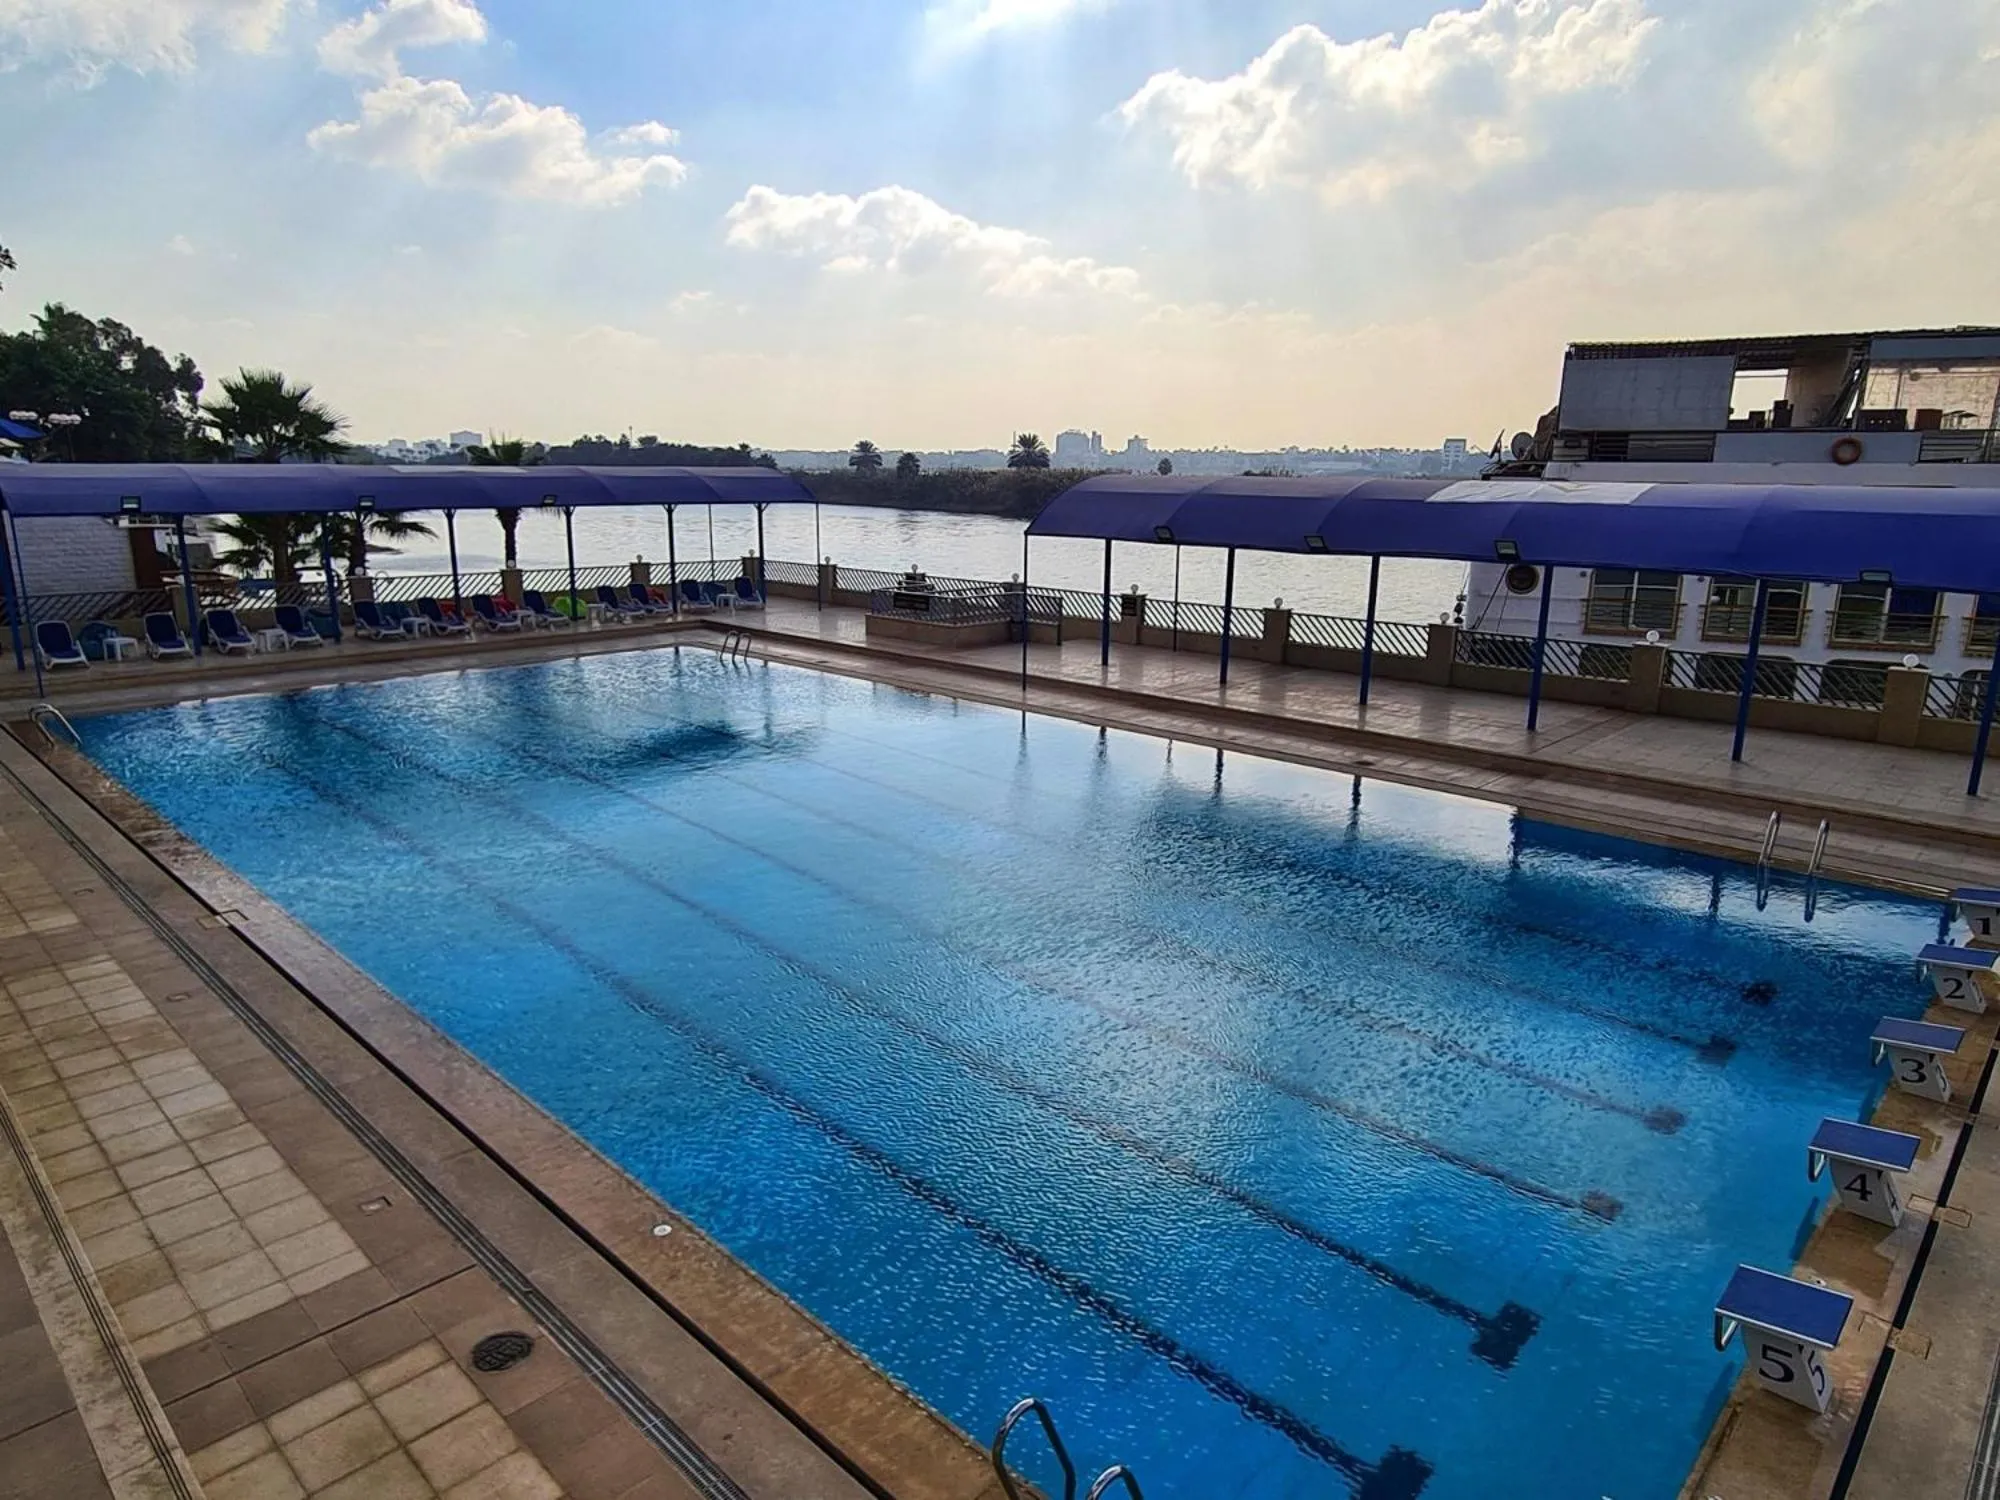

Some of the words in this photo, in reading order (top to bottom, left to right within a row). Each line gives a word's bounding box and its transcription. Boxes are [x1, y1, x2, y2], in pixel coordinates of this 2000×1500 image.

[1975, 916, 1992, 936] 1
[1943, 977, 1965, 999] 2
[1900, 1058, 1927, 1083] 3
[1844, 1173, 1873, 1202] 4
[1758, 1343, 1795, 1383] 5
[1807, 1350, 1826, 1397] 5
